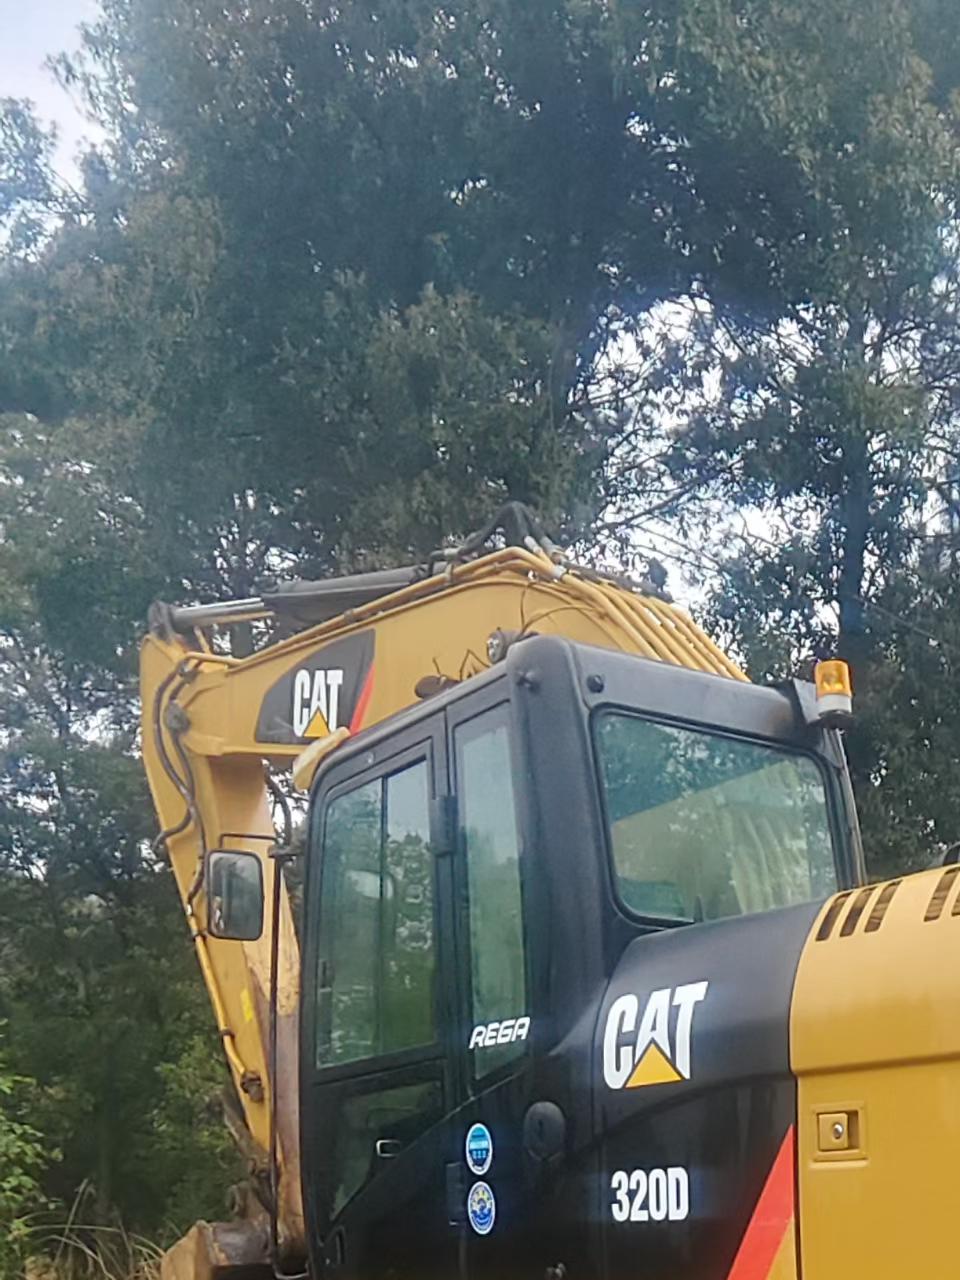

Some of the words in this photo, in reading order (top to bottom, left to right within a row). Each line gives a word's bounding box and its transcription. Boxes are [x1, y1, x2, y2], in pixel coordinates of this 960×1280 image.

[293, 669, 343, 737] CAT
[603, 981, 709, 1089] CAT
[611, 1166, 690, 1222] 320D
